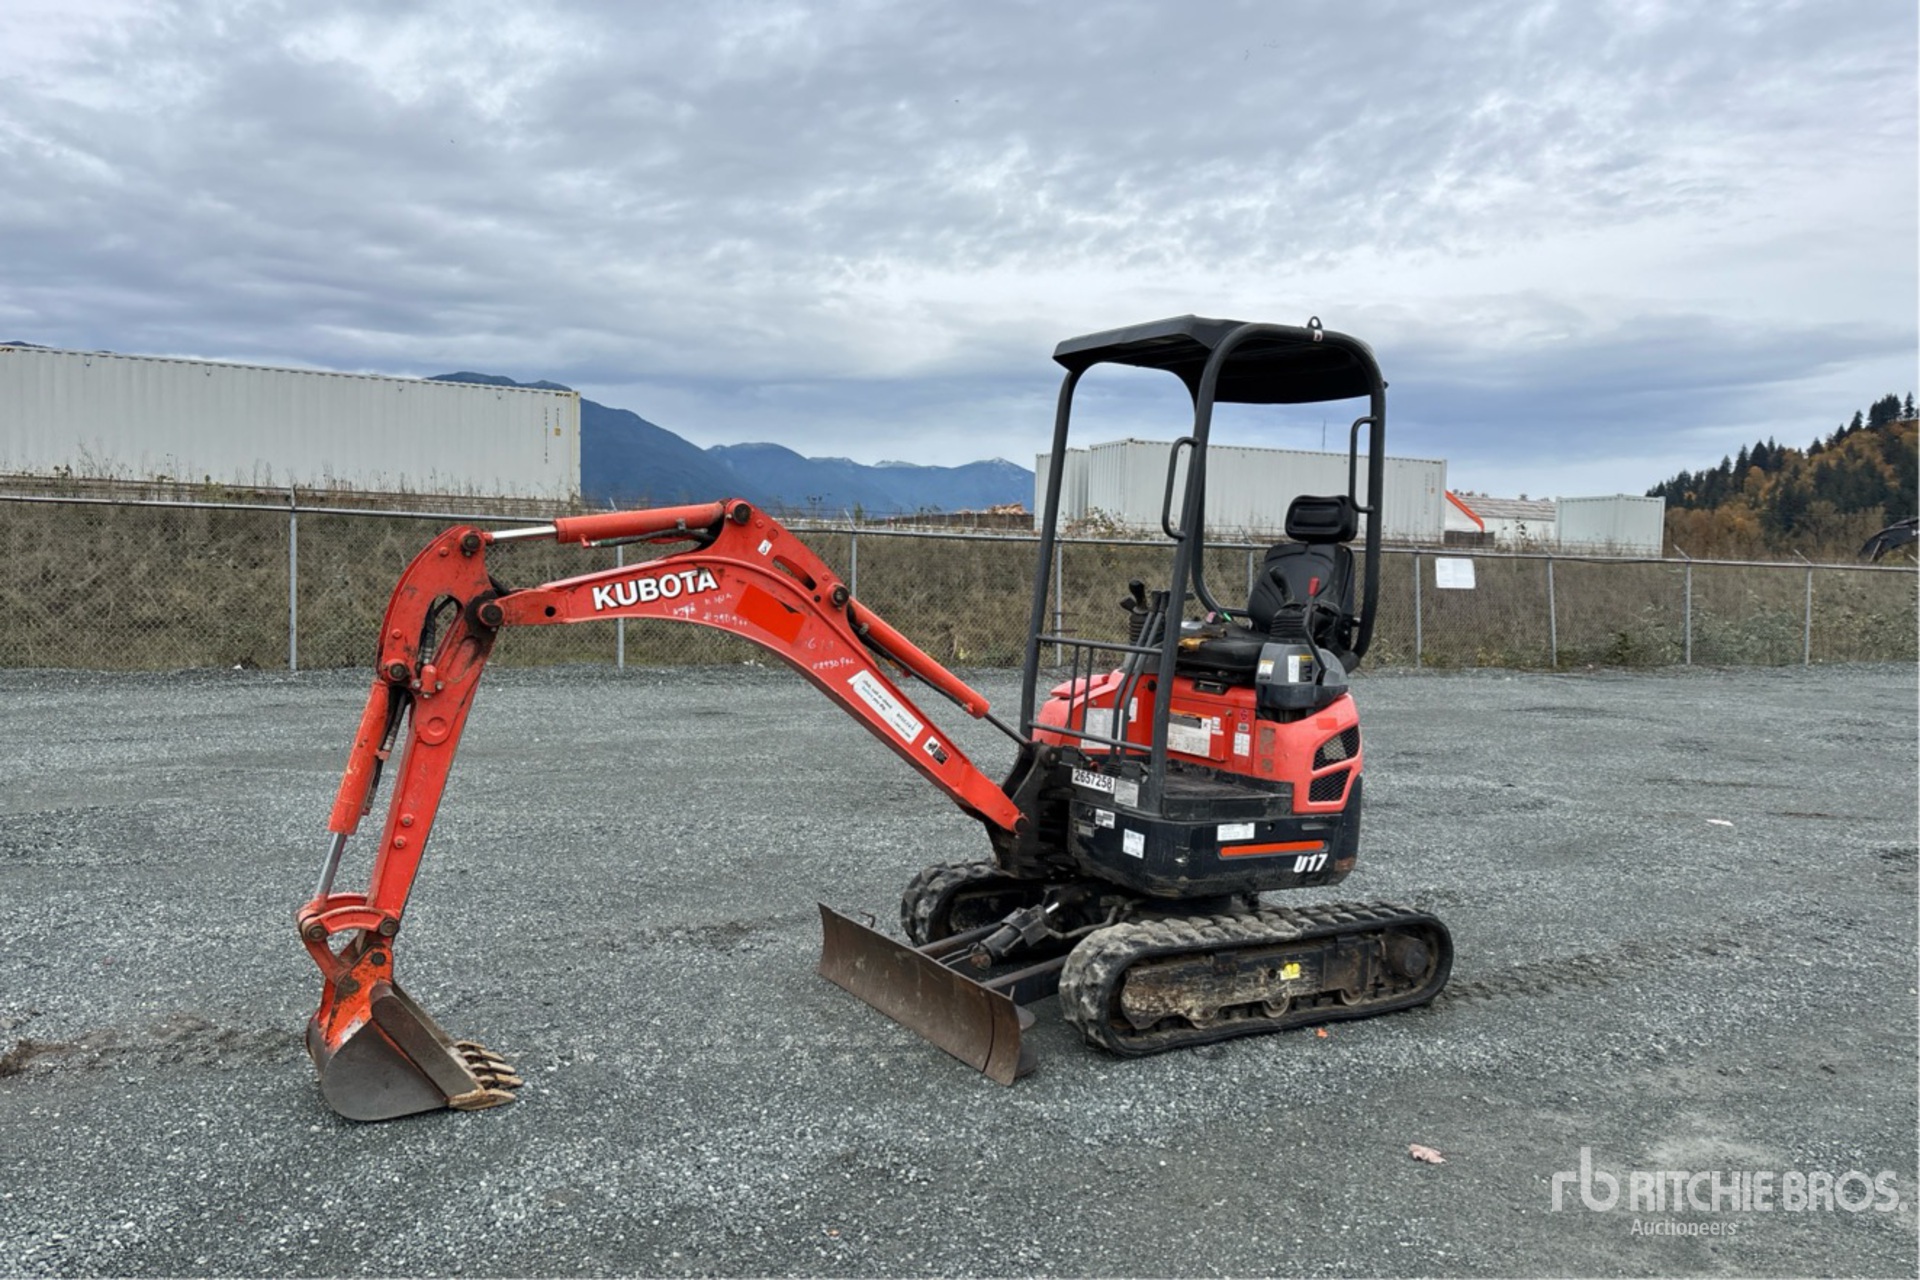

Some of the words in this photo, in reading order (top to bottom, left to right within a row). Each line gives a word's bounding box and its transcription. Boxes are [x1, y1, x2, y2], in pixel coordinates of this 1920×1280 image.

[592, 569, 718, 611] KUBOTA
[1074, 770, 1112, 790] 2657258
[1293, 853, 1328, 873] U17
